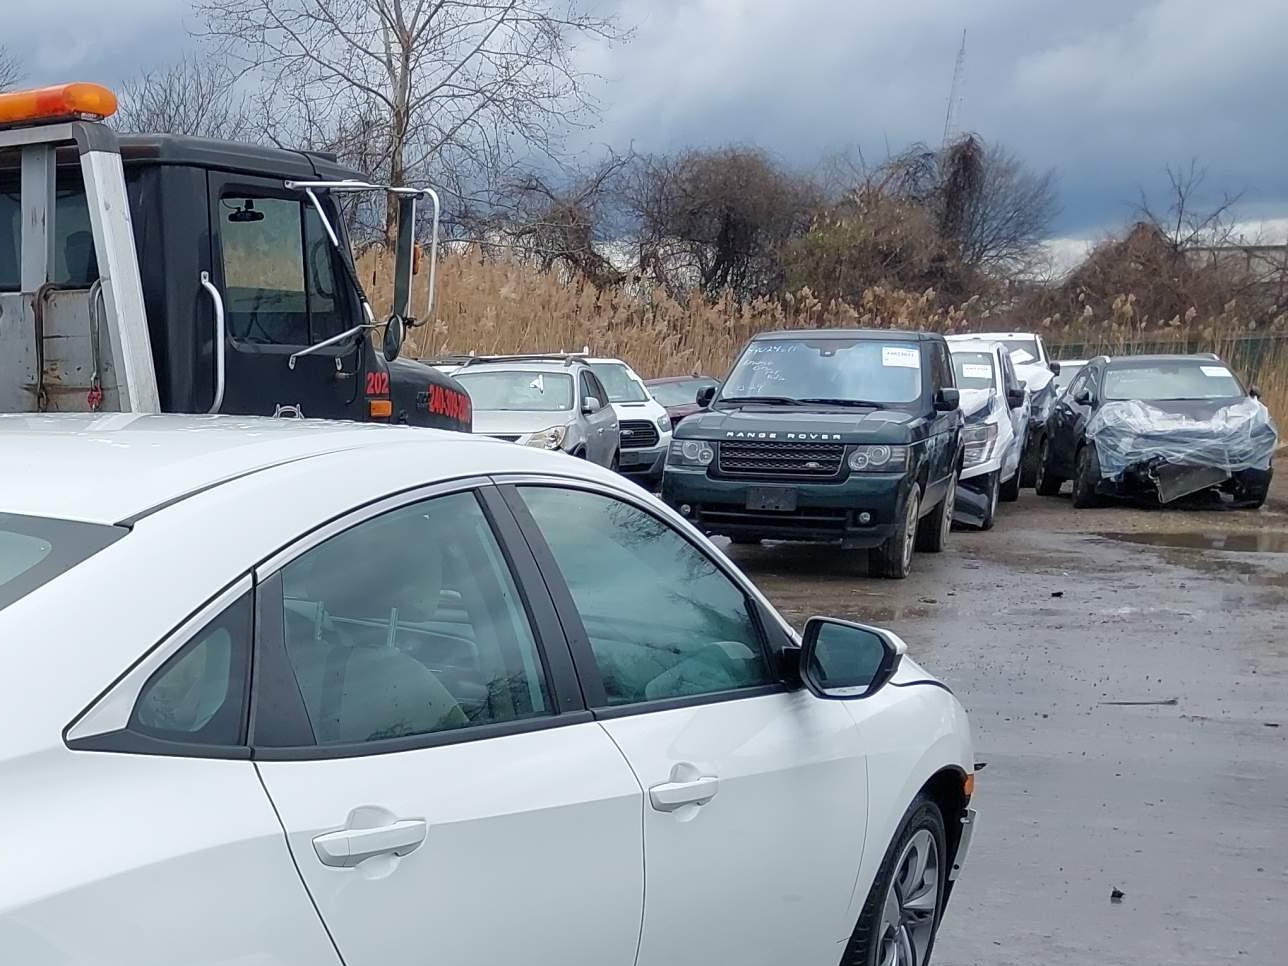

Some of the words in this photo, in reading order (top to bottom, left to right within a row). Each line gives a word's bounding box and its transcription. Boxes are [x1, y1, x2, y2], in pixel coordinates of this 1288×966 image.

[366, 372, 390, 395] 202
[726, 431, 777, 439] RANGE
[787, 432, 841, 440] ROVER
